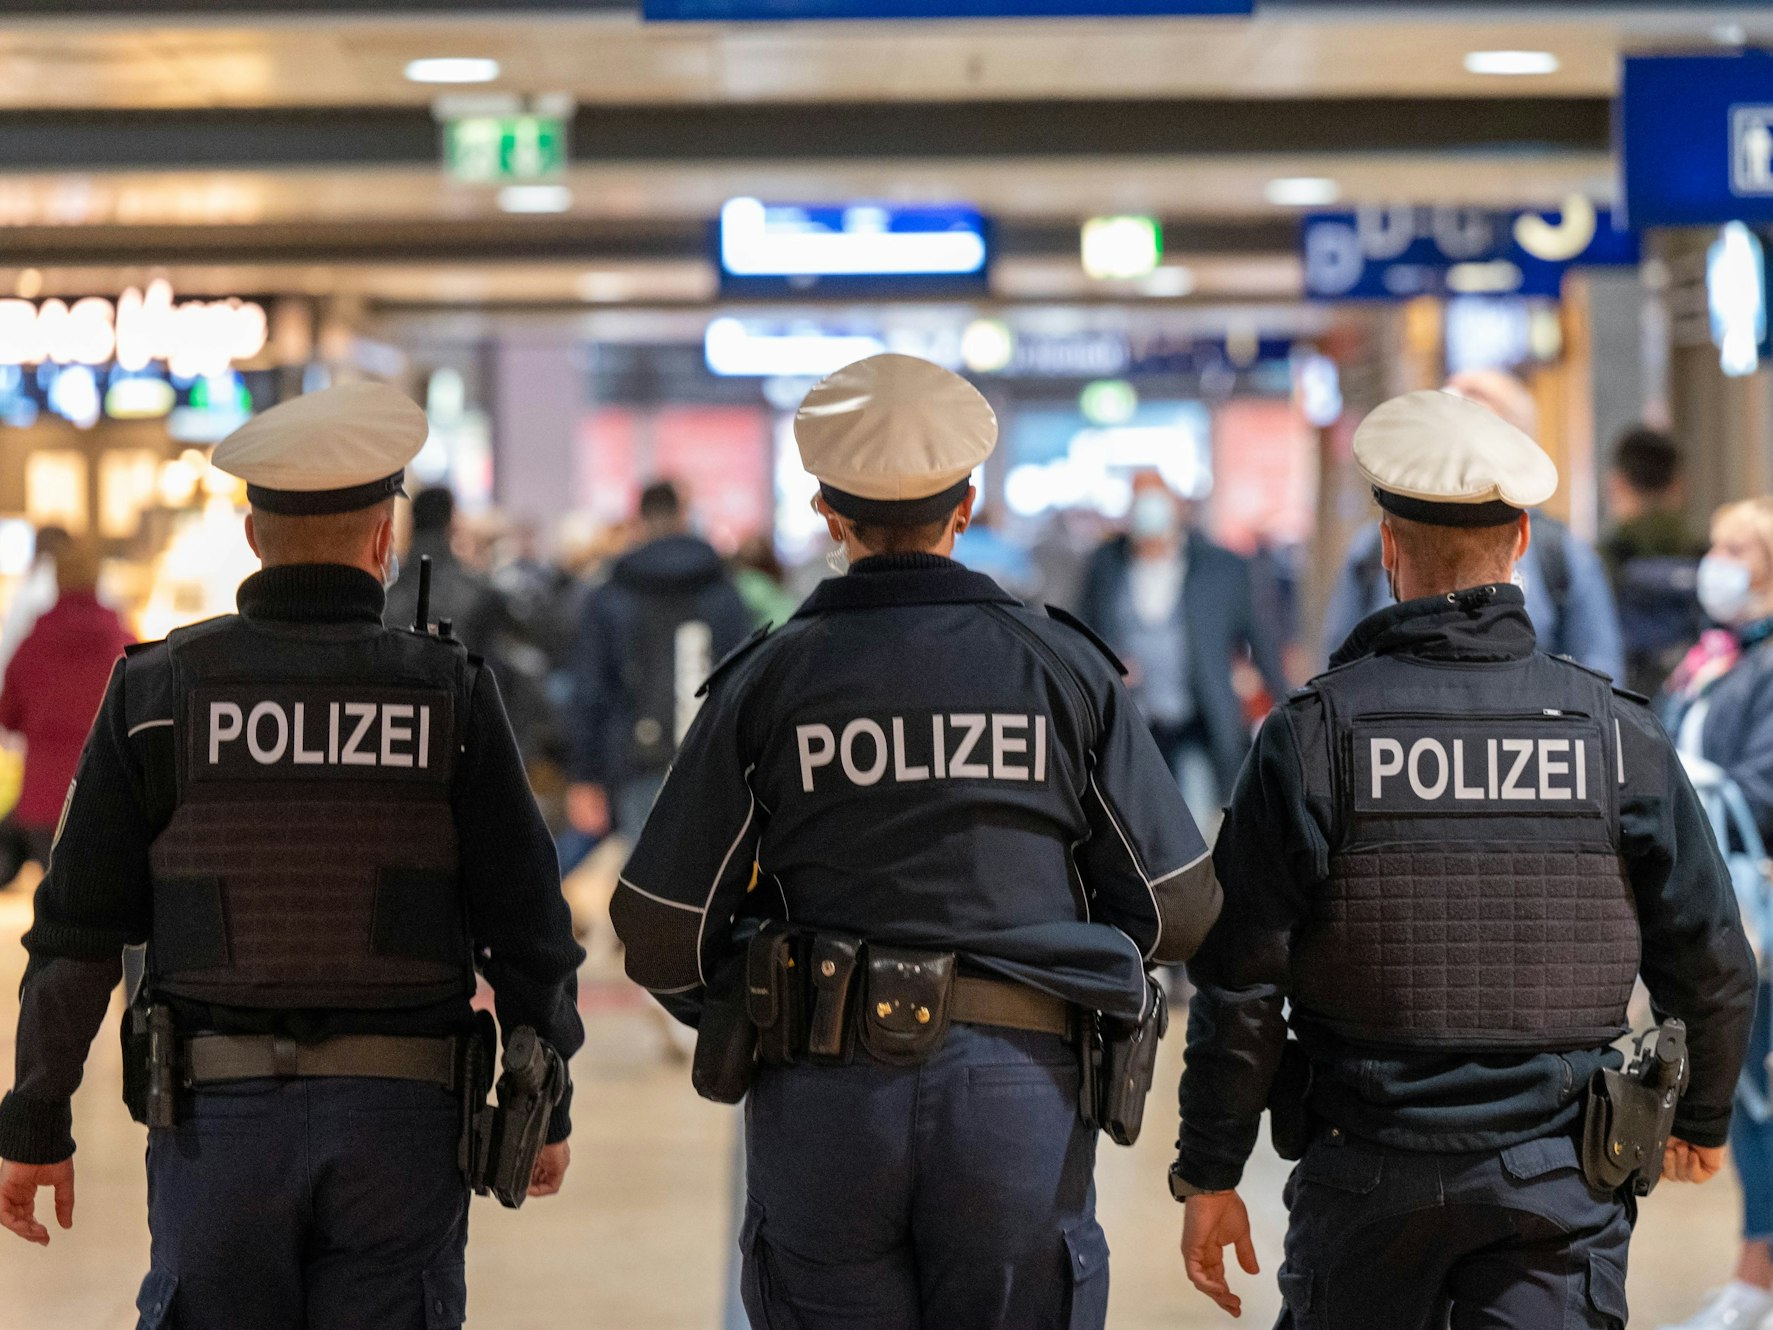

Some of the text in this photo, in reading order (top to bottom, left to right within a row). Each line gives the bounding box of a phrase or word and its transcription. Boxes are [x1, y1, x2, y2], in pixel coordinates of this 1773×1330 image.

[209, 701, 430, 768] POLIZEI
[796, 713, 1046, 792] POLIZEI
[1370, 737, 1587, 800] POLIZEI
